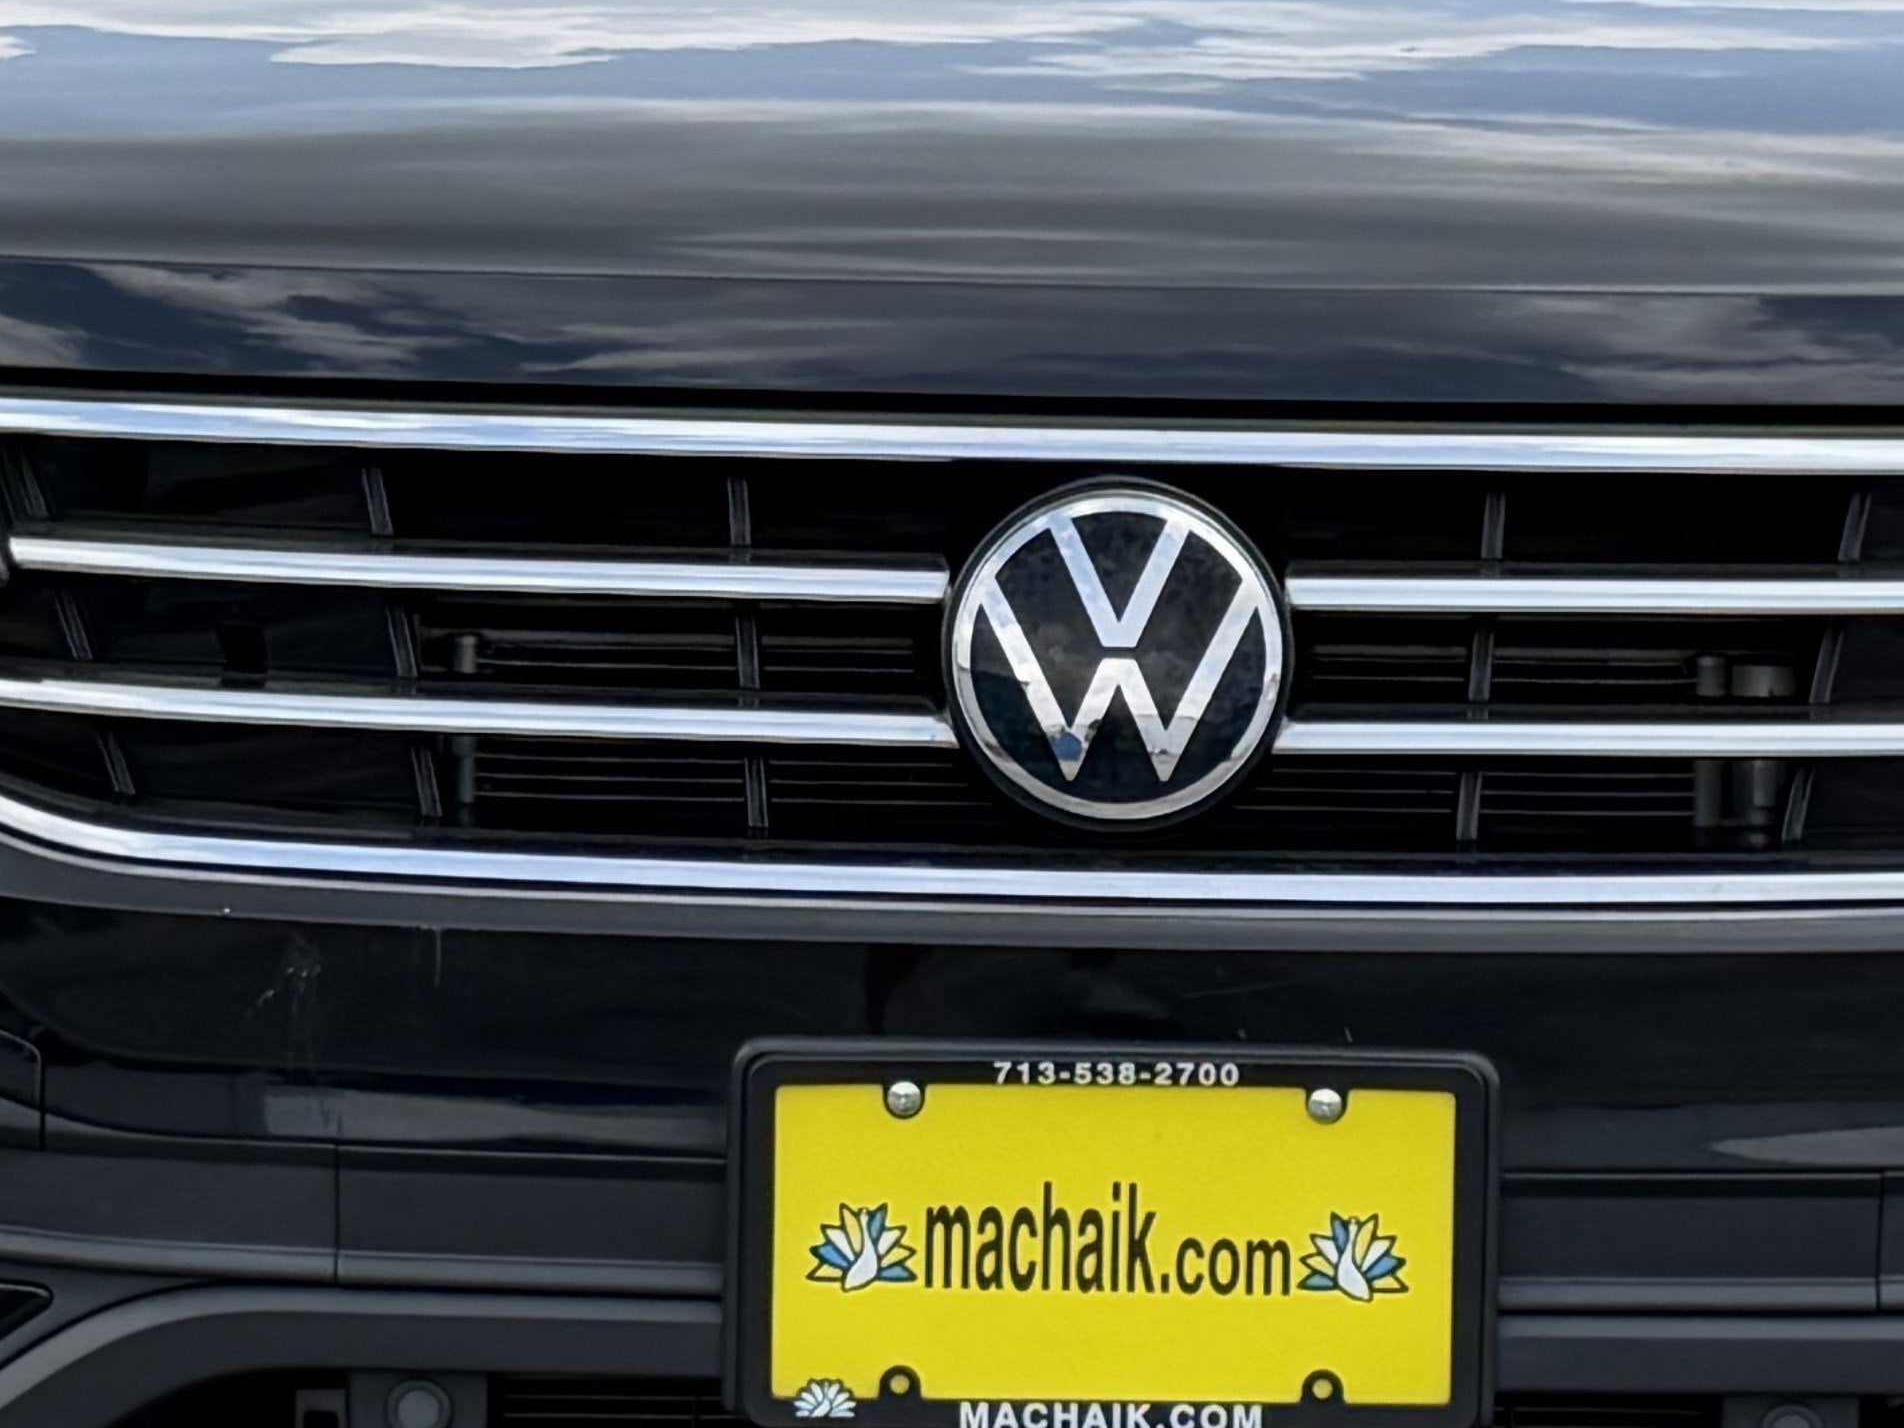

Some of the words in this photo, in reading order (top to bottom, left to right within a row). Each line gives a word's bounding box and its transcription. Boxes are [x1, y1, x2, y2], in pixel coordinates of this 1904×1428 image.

[976, 508, 1264, 784] VW
[993, 1060, 1240, 1086] 713-538-2700
[924, 1181, 1292, 1296] machaik.com
